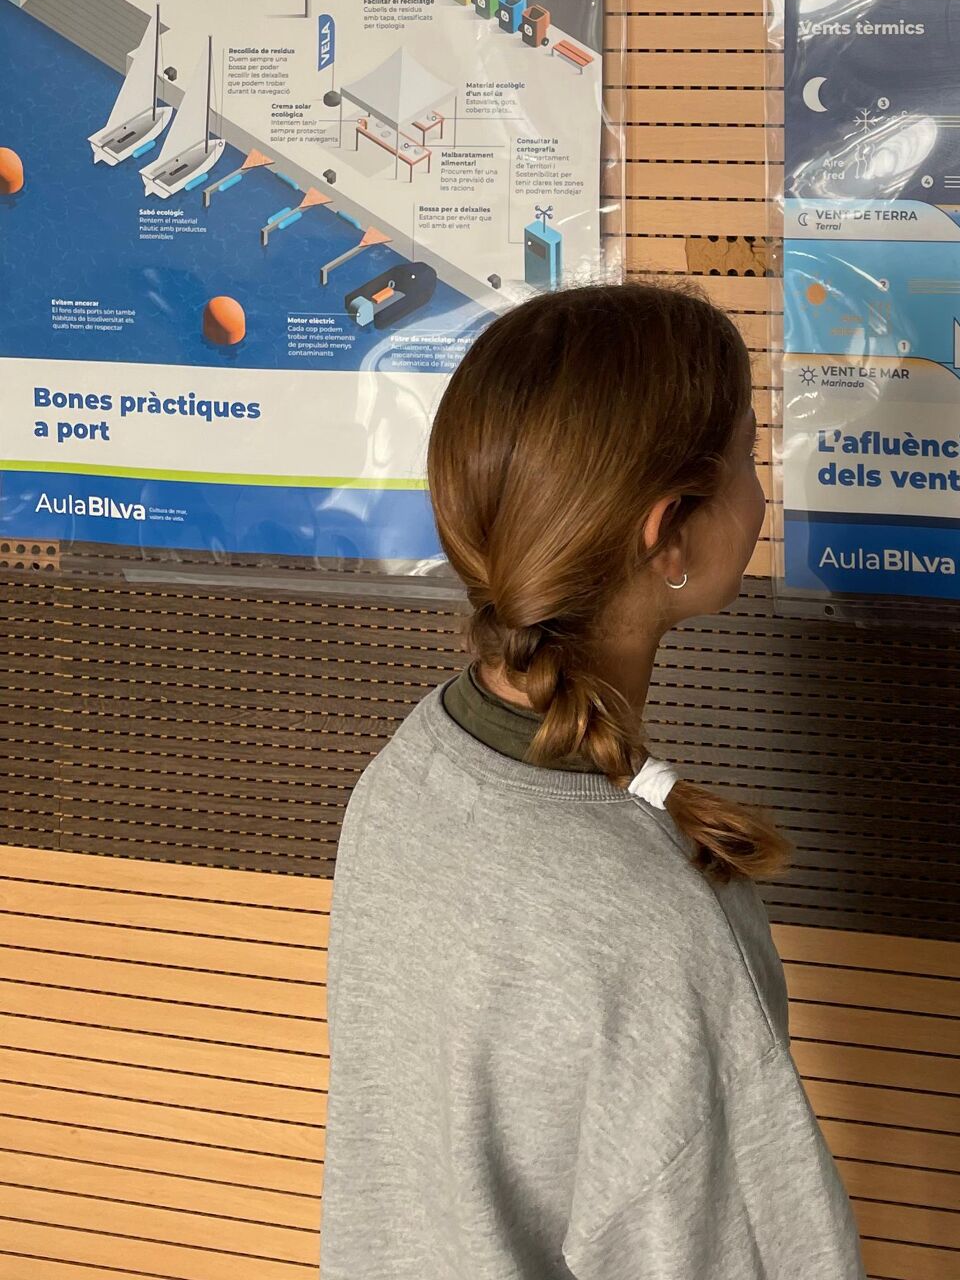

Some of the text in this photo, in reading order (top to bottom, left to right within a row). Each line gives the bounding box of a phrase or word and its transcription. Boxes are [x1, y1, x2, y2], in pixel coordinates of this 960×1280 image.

[799, 20, 925, 36] Vents tèrmics
[321, 22, 330, 65] VELA
[496, 82, 525, 90] ecològic
[823, 159, 845, 168] Aire
[816, 210, 917, 220] VENT DE TERRA
[816, 222, 841, 231] Terral
[821, 366, 910, 379] VENT DE MAR
[821, 379, 864, 388] Marinada
[34, 388, 261, 422] Bones pràctiques
[34, 420, 110, 442] a port
[818, 463, 881, 487] dels
